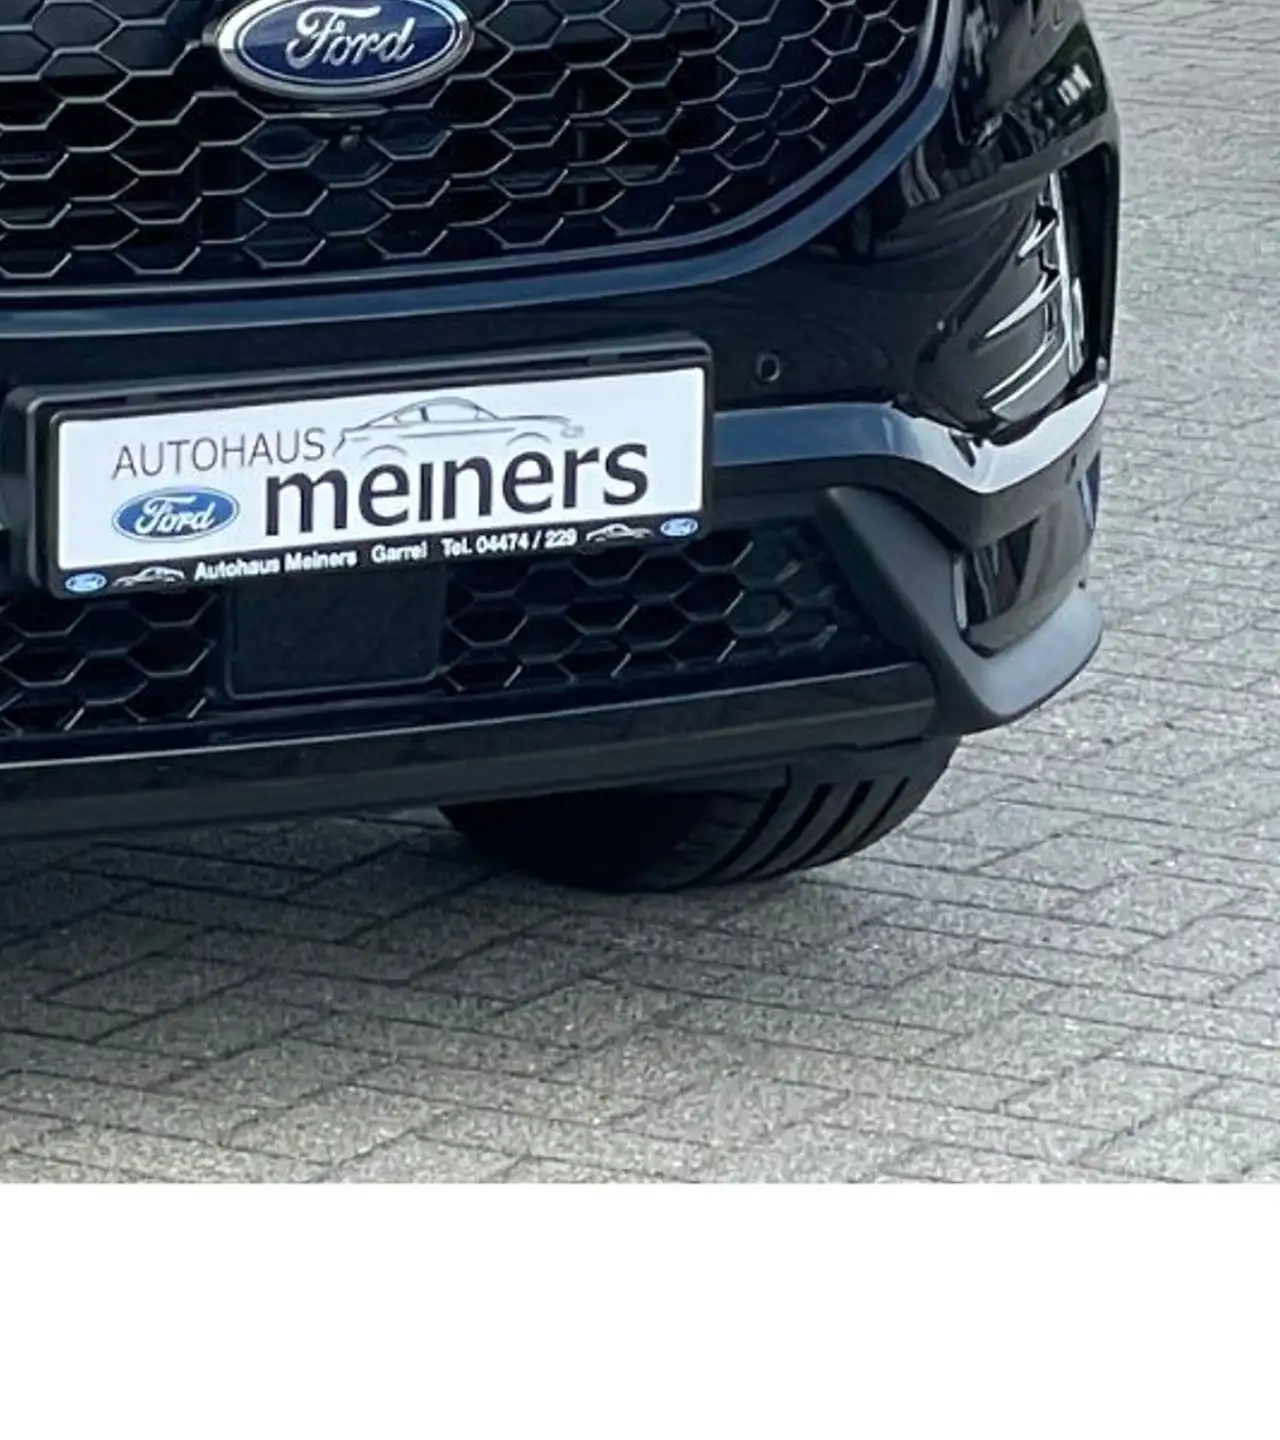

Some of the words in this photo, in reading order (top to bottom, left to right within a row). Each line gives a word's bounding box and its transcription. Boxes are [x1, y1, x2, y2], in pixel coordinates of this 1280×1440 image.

[284, 4, 417, 70] Ford
[111, 427, 325, 480] AUTOHAUS
[133, 495, 217, 534] Ford
[264, 440, 650, 537] meiners
[194, 558, 281, 582] Autohaus
[284, 551, 357, 573] Meiners
[371, 541, 429, 563] Garrel
[441, 535, 472, 558] Tel.
[475, 531, 530, 556] 04474
[544, 528, 578, 549] 229
